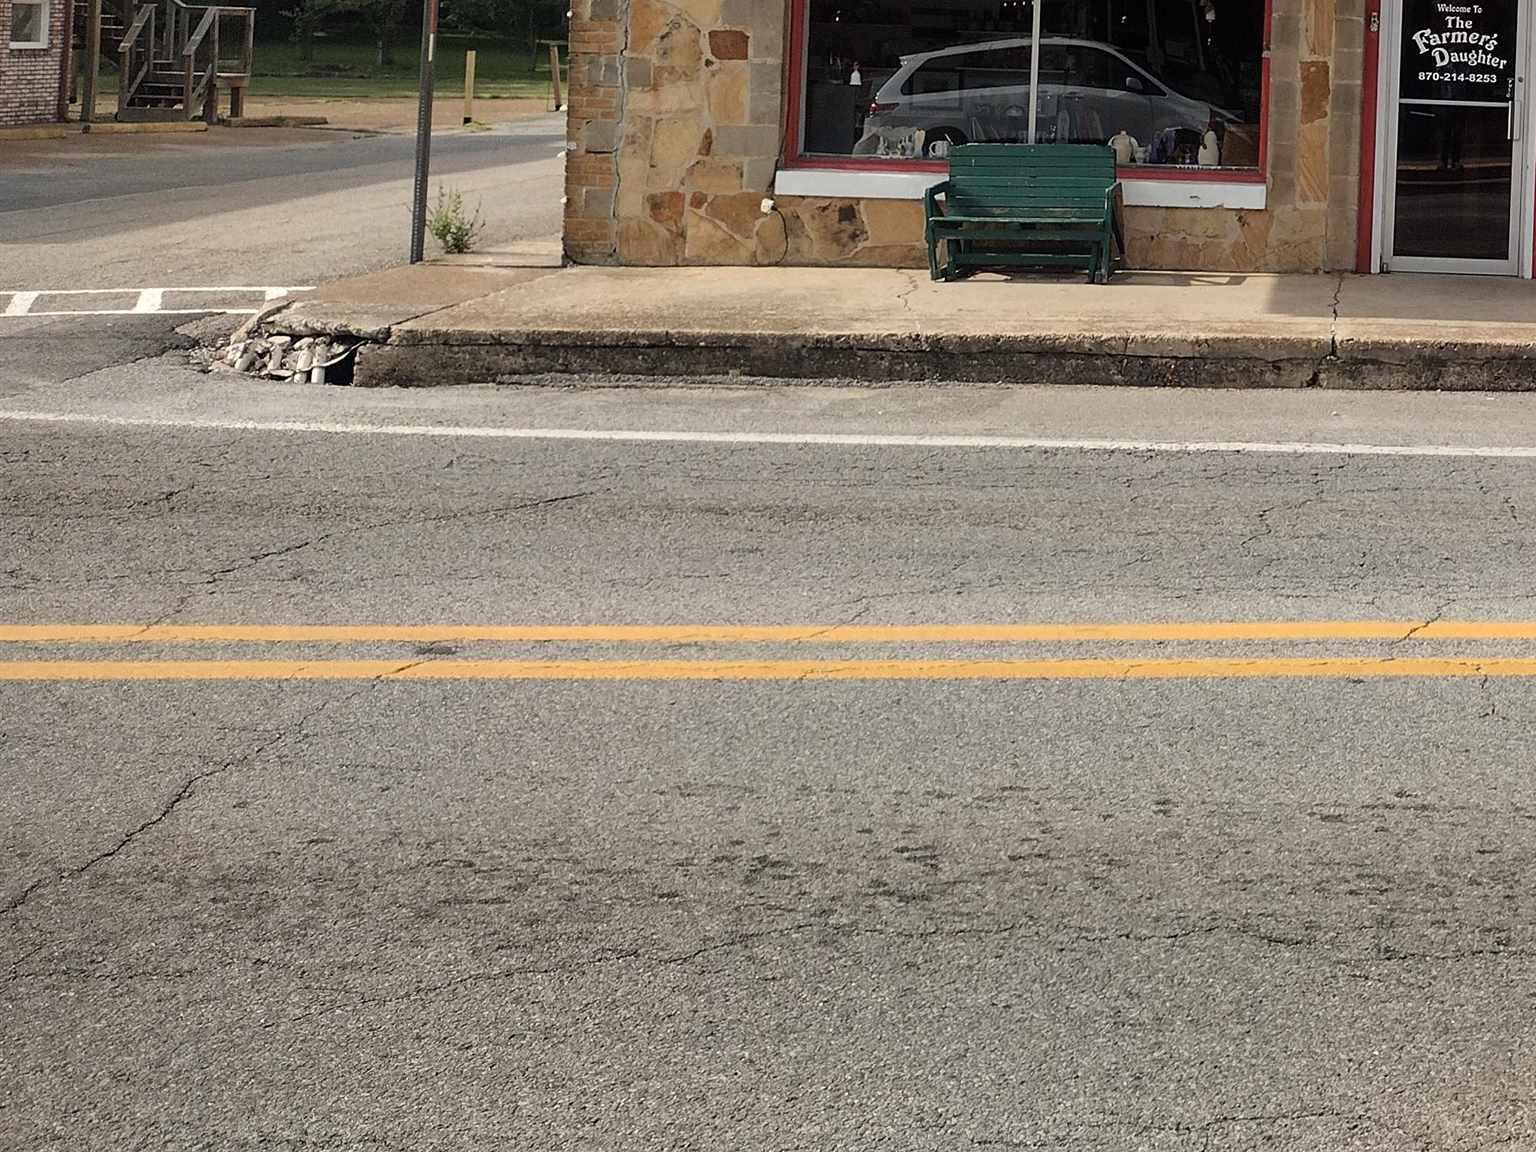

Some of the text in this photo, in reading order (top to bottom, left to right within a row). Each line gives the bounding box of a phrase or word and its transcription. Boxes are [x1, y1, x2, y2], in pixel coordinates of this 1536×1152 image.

[1437, 3, 1483, 14] Welcome To
[1445, 16, 1473, 29] The
[1412, 28, 1499, 55] Farmer's
[1431, 47, 1508, 69] Daughter
[1418, 72, 1498, 83] 870-214-8253
